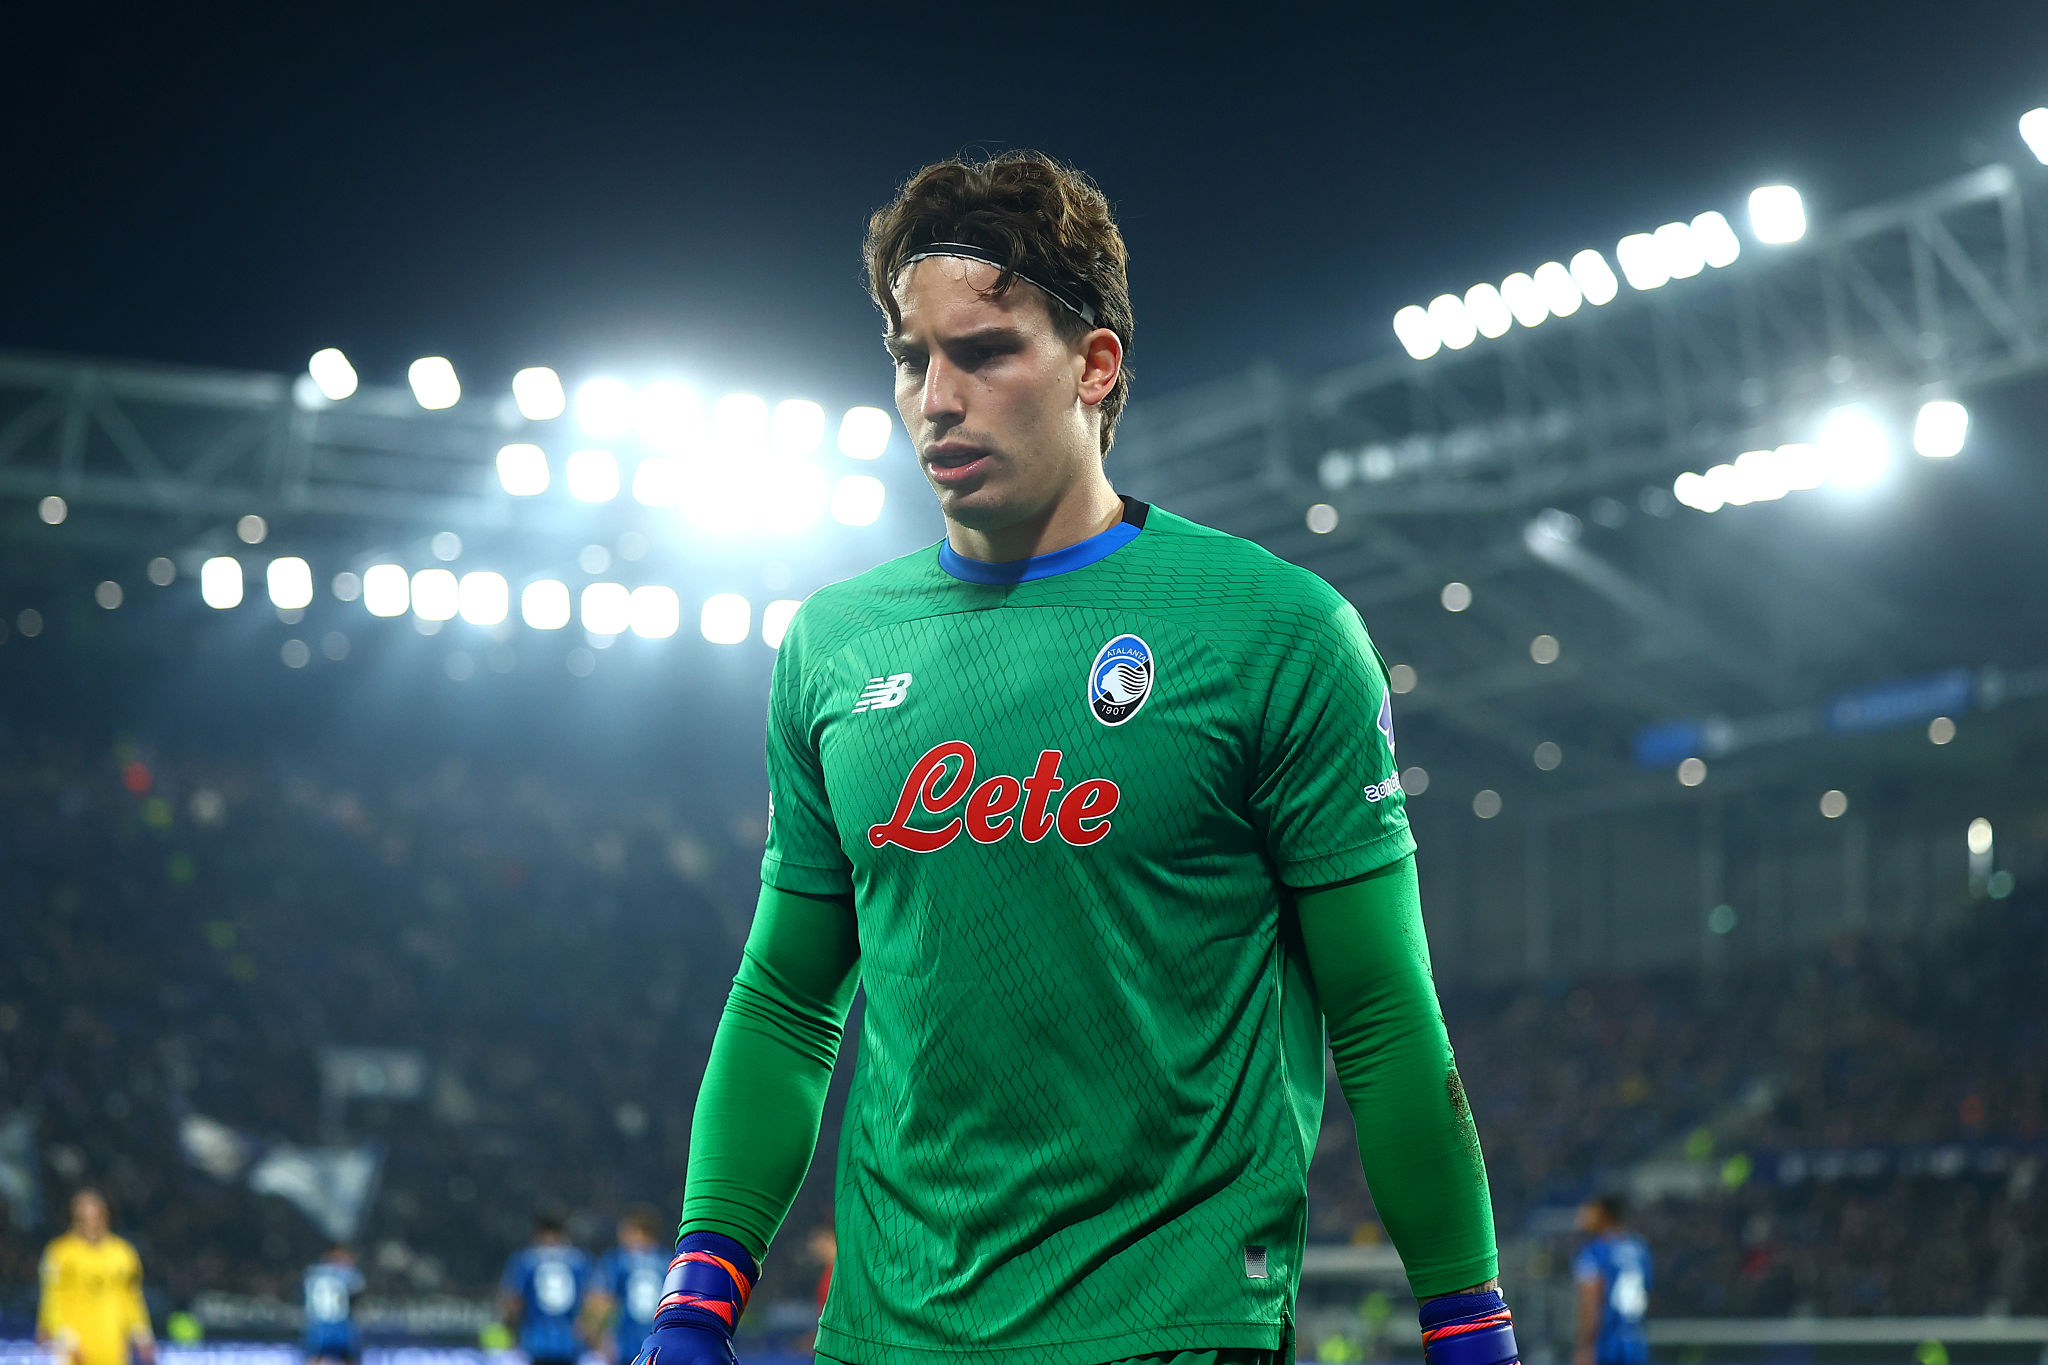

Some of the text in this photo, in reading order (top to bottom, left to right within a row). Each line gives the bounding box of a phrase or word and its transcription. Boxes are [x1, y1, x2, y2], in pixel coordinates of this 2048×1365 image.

[1107, 647, 1147, 662] ATALANTA
[1101, 704, 1126, 716] 1907
[868, 740, 1120, 853] Lete
